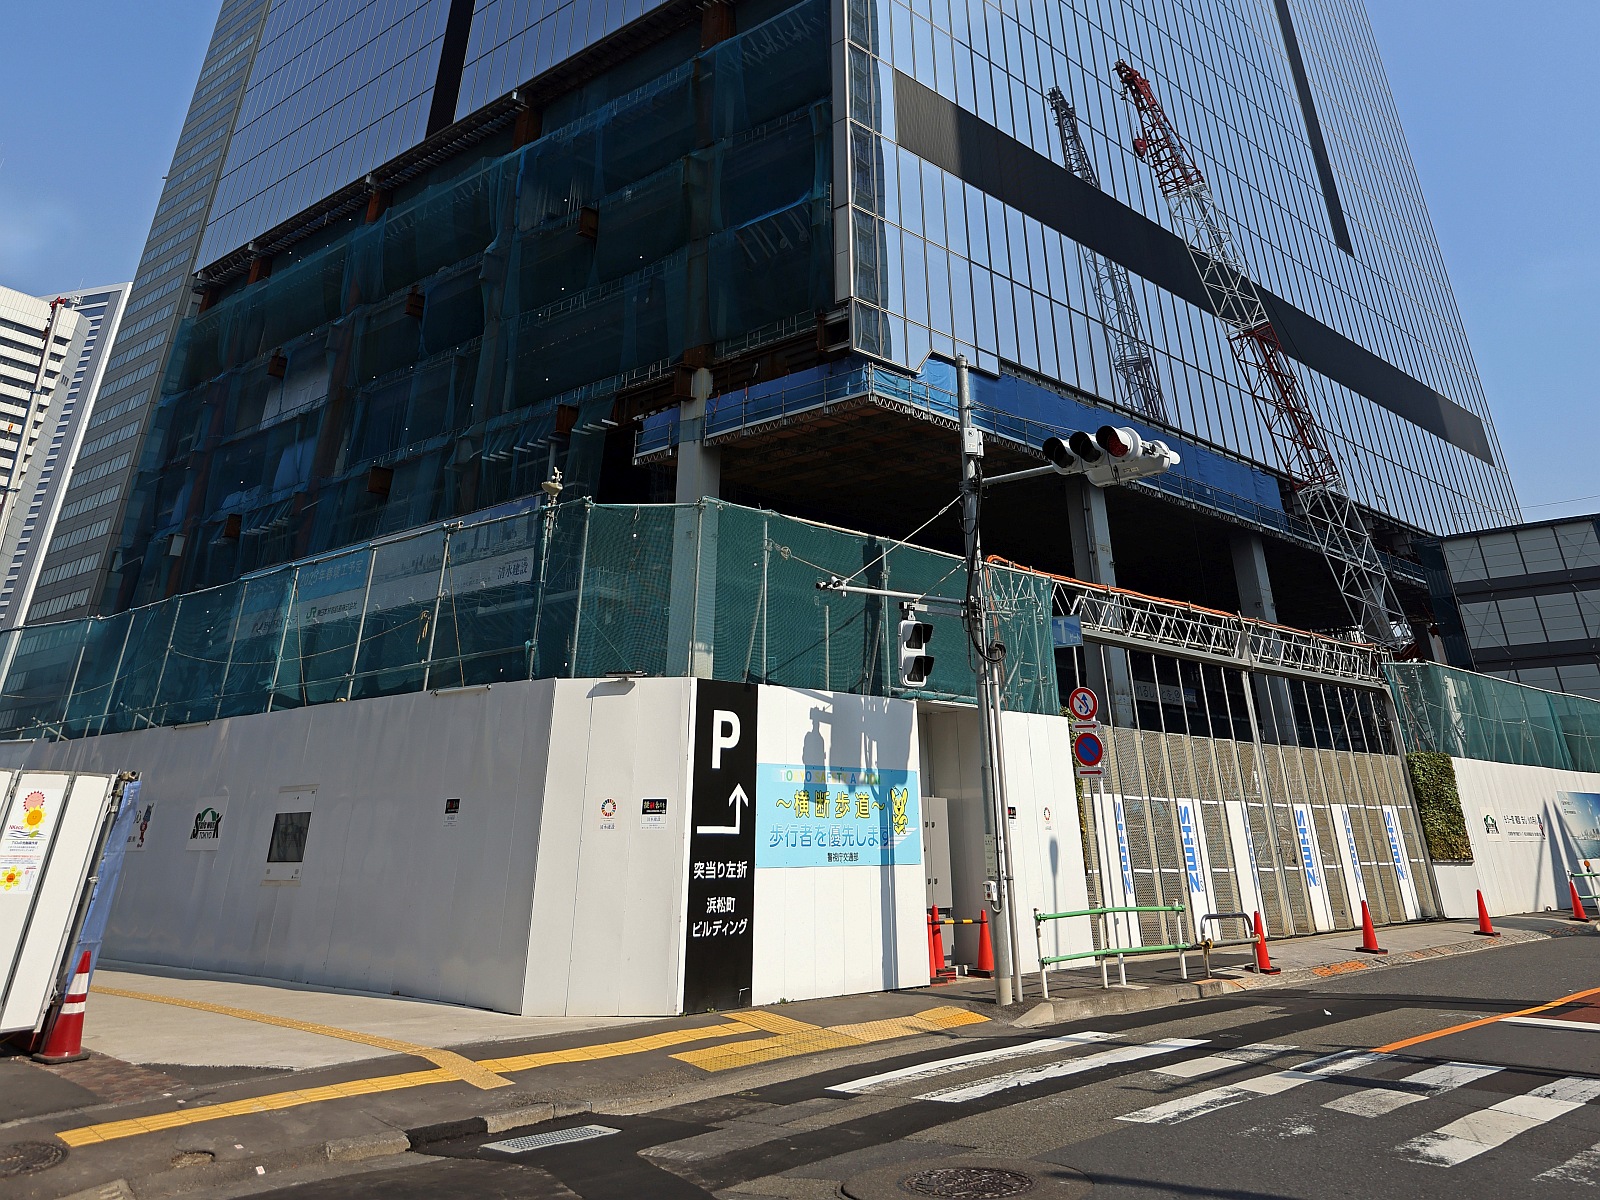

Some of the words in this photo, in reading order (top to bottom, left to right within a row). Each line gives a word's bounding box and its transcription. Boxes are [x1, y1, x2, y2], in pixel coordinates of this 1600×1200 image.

[711, 709, 741, 769] P
[693, 861, 748, 879] 突当り左折
[706, 897, 736, 913] 浜松町
[692, 918, 748, 937] ビルディング
